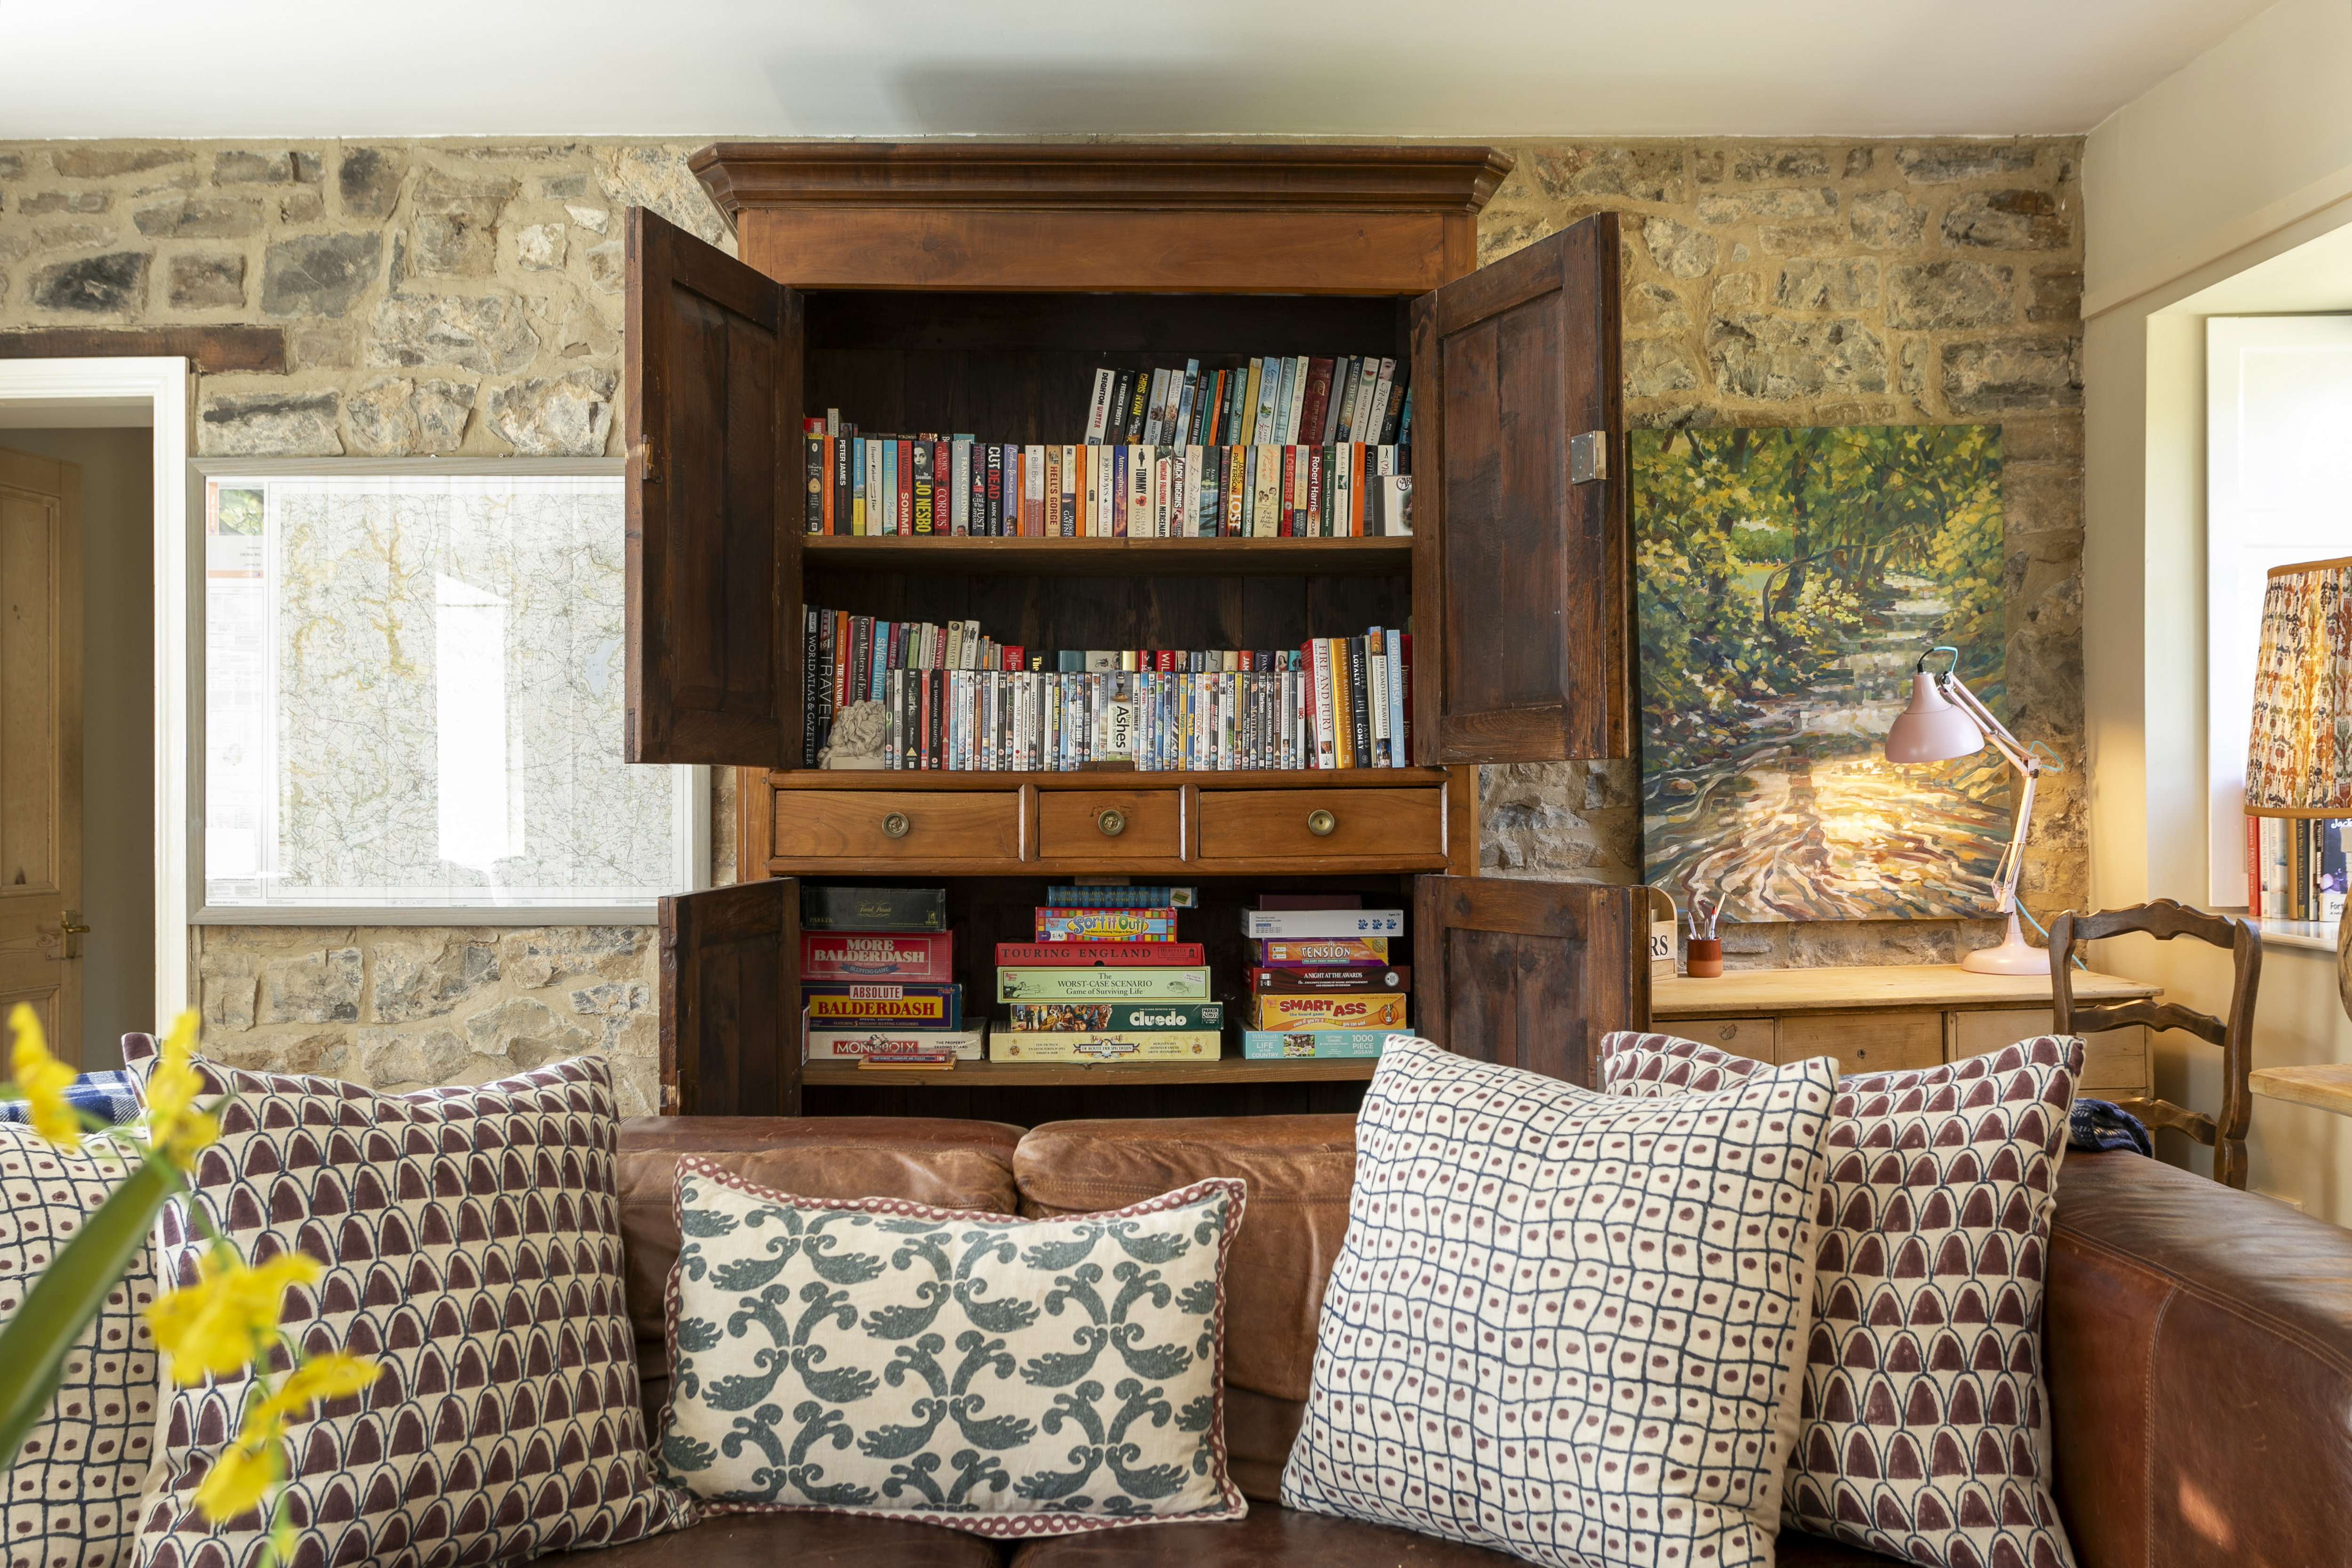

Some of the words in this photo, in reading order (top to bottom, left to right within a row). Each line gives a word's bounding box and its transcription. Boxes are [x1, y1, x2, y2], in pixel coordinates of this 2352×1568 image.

[1098, 372, 1109, 406] DEIGHTON
[1118, 383, 1127, 406] FREDERICK
[1137, 374, 1148, 393] CHRIS
[1133, 395, 1144, 415] RYAN
[1094, 406, 1103, 428] WINTER
[1309, 401, 1319, 440] SEPULCHRE
[988, 447, 1001, 469] CUT
[1175, 460, 1183, 479] JACK
[1136, 468, 1146, 494] TOMMY
[1285, 454, 1294, 499] LOBSTERS
[1311, 456, 1320, 484] Robert
[916, 481, 931, 495] JO
[988, 470, 1000, 499] DEAD
[1174, 481, 1183, 508] HIGGINS
[937, 488, 947, 526] CORPUS
[1311, 486, 1319, 512] Harris
[916, 499, 931, 532] NESBO
[1229, 495, 1242, 529] LOST
[818, 653, 833, 726] TRAVEL
[835, 679, 844, 709] HANDBAG
[1320, 675, 1329, 699] AND
[1116, 706, 1129, 748] Ashes
[1322, 704, 1331, 732] FURY
[806, 713, 815, 765] GAZETTEER
[859, 904, 874, 913] Trivial
[1073, 914, 1105, 934] Sort
[1108, 917, 1117, 930] it
[1118, 915, 1145, 935] Out!
[814, 950, 925, 963] BALDERDASH
[846, 940, 894, 951] MORE
[1001, 949, 1070, 958] TOURING
[1079, 949, 1151, 958] ENGLAND
[1301, 942, 1351, 958] TENSION
[853, 987, 899, 998] ABSOLUTE
[818, 1002, 935, 1016] BALDERDASH
[1129, 1011, 1187, 1026] Cluedo
[1279, 999, 1334, 1012] SMART
[1333, 1002, 1367, 1017] ASS
[837, 1042, 914, 1053] MONPOLY
